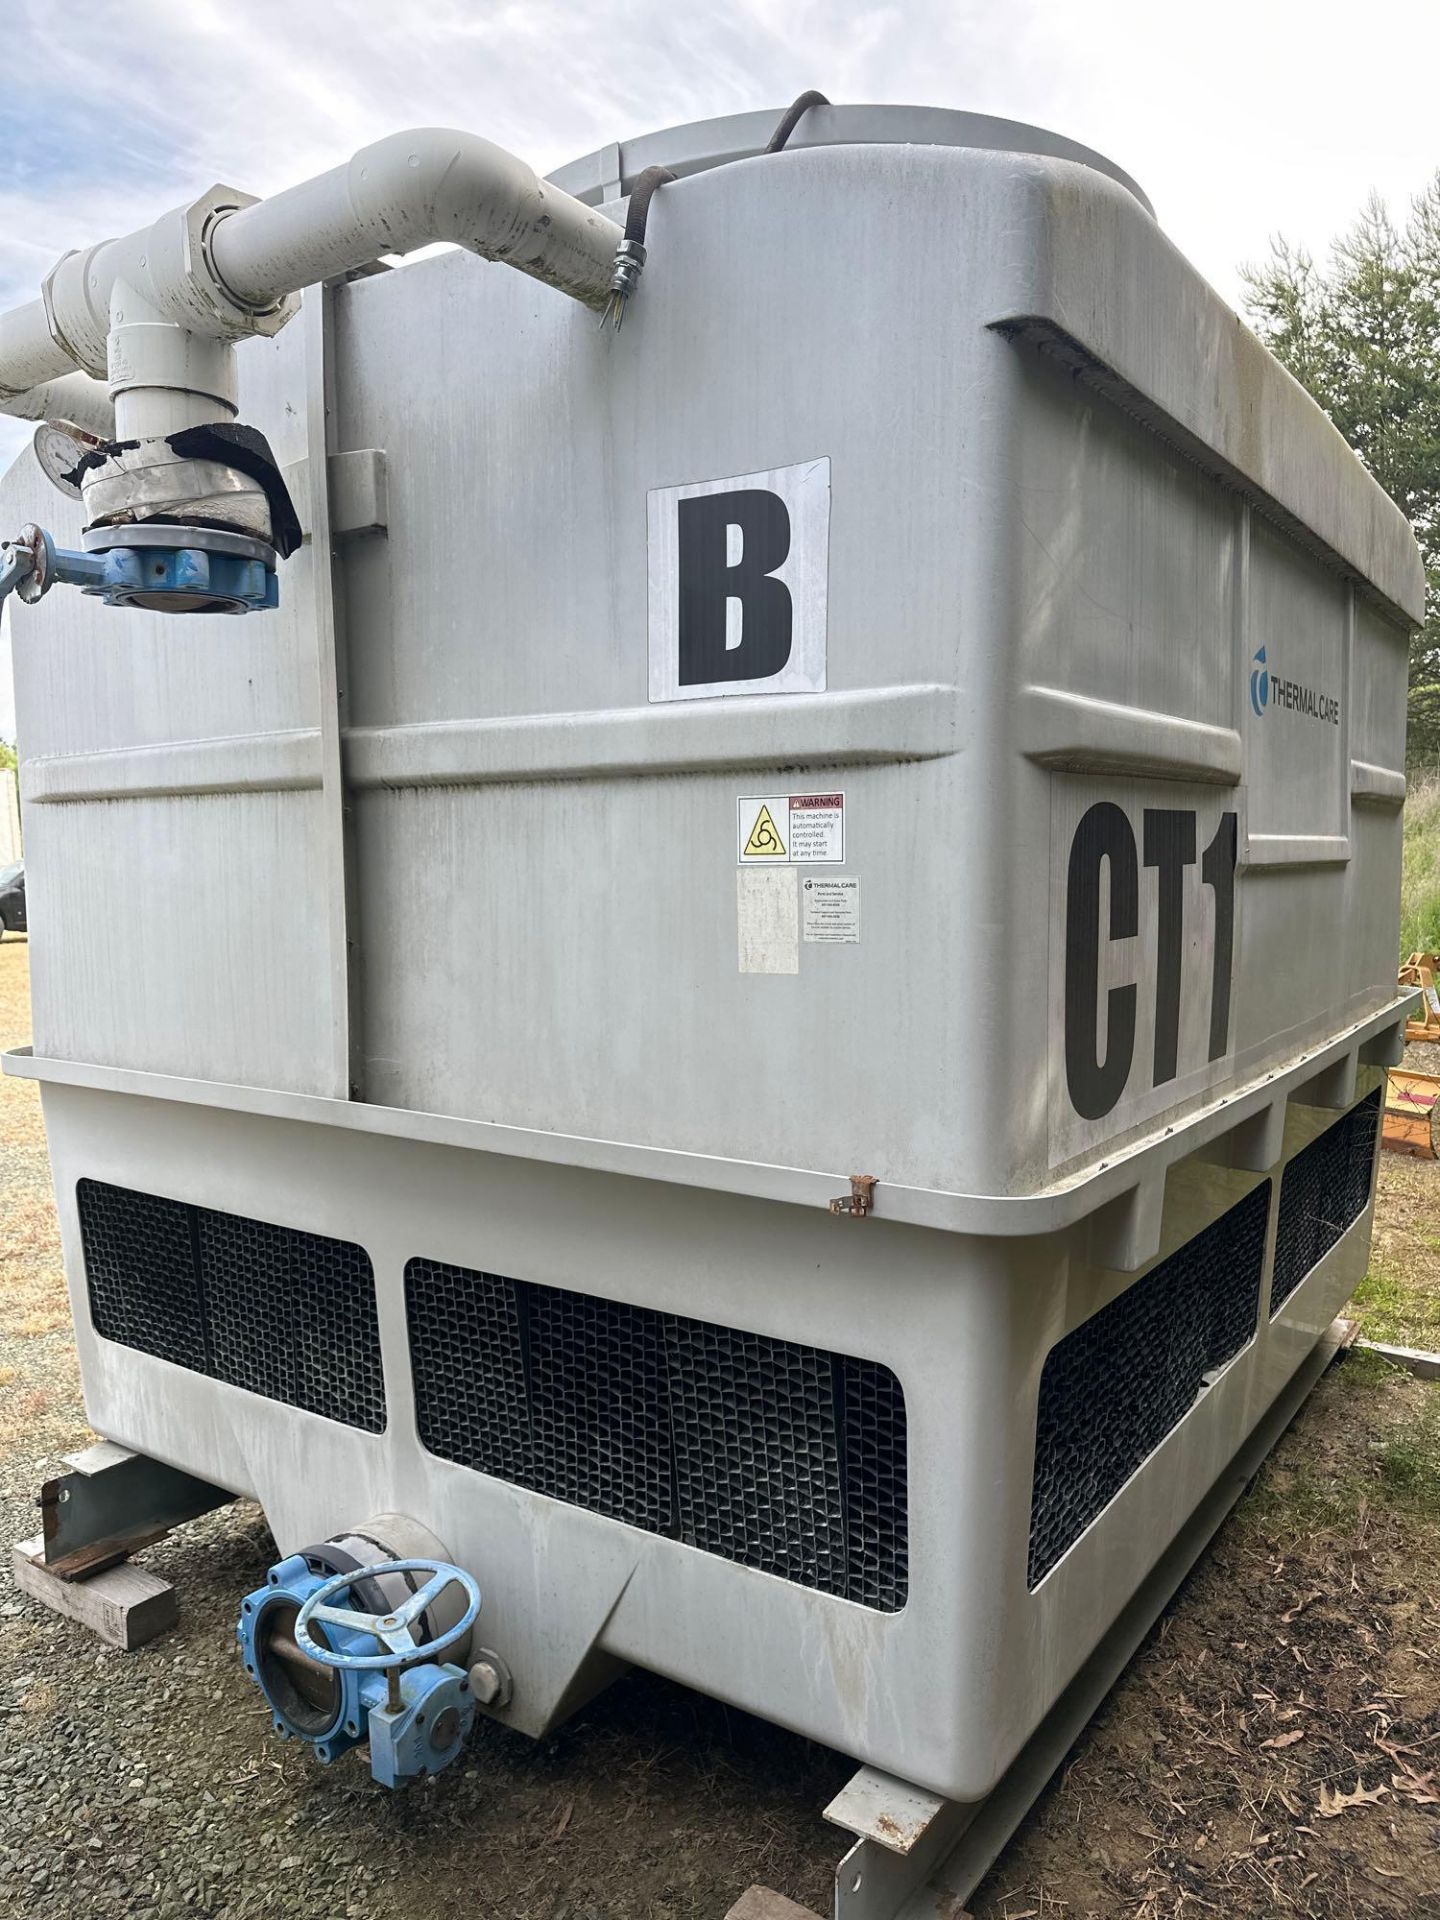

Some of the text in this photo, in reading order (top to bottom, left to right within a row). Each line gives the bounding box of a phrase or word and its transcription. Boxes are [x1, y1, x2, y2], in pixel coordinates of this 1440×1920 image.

[678, 489, 793, 686] B
[1271, 675, 1339, 725] THERMAL CARE
[801, 796, 840, 807] WARNING
[806, 812, 833, 820] machine
[792, 821, 834, 831] automatically
[799, 841, 812, 849] may
[1065, 801, 1238, 1121] CT1
